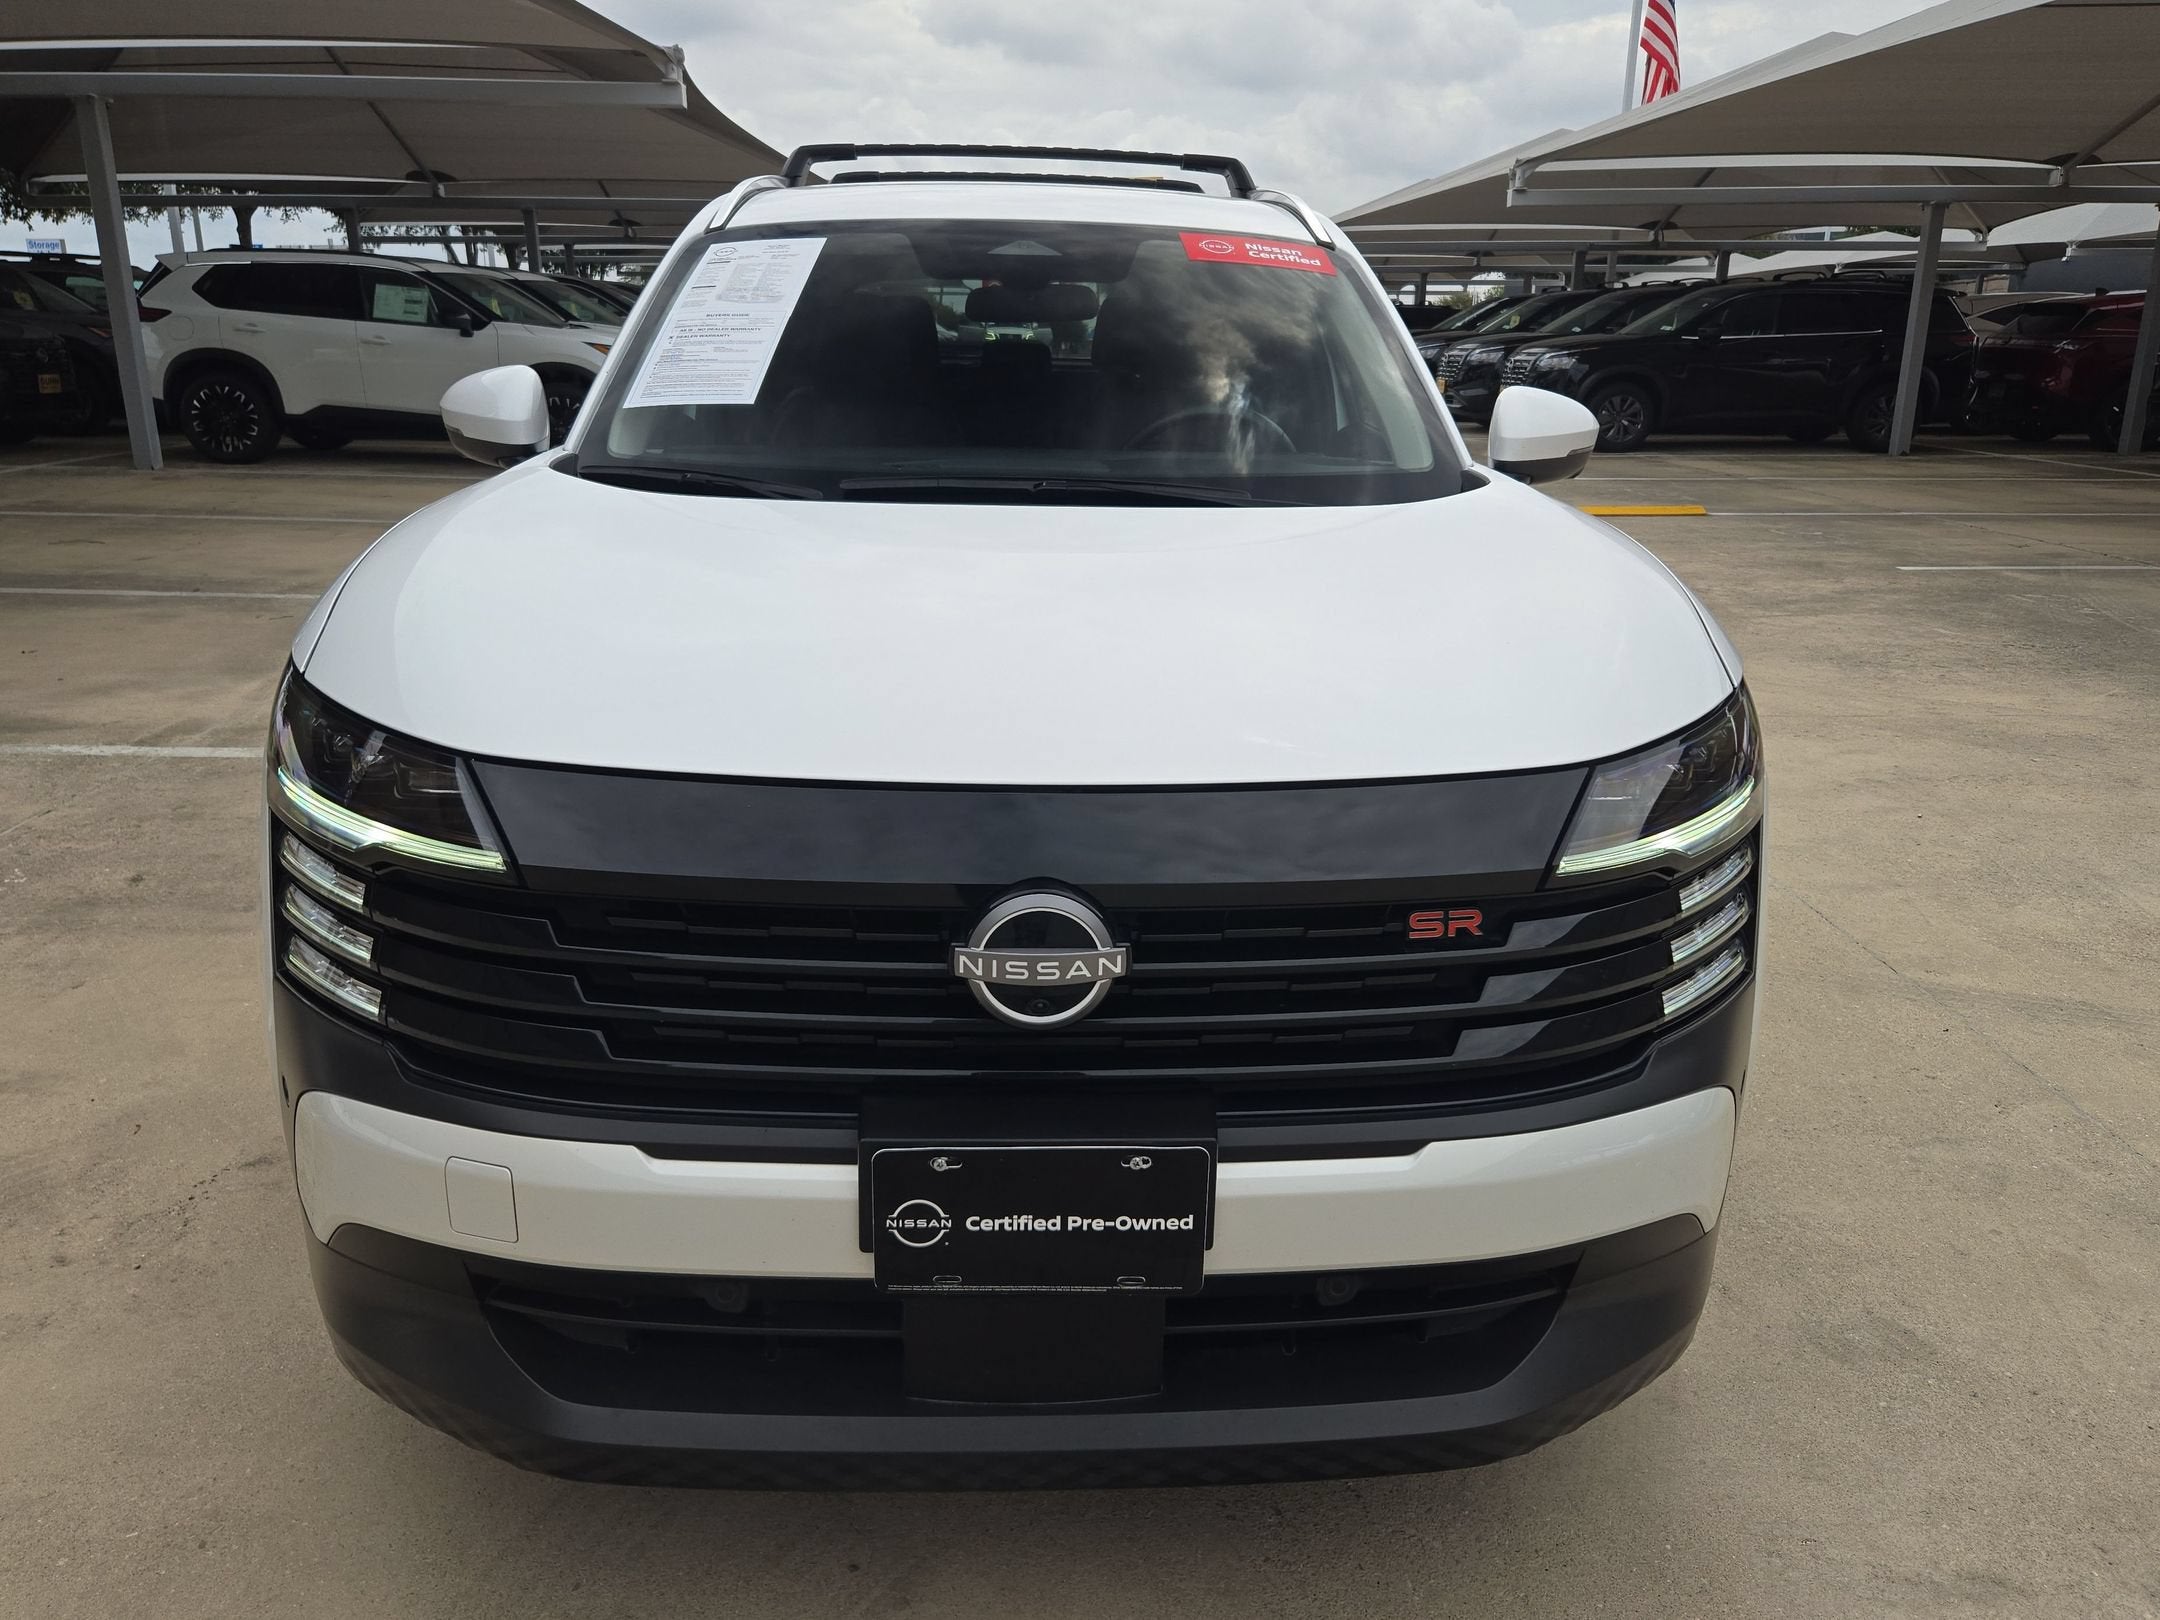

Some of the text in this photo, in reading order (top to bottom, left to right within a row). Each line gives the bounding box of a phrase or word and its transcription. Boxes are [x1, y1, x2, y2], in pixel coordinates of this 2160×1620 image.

[28, 240, 60, 251] Storage
[1244, 243, 1303, 256] Nissan
[1248, 250, 1322, 267] Certified
[1408, 909, 1483, 939] SR
[959, 954, 1122, 980] NISSAN
[886, 1214, 1194, 1232] NISSAN Certified Pre-Owned
